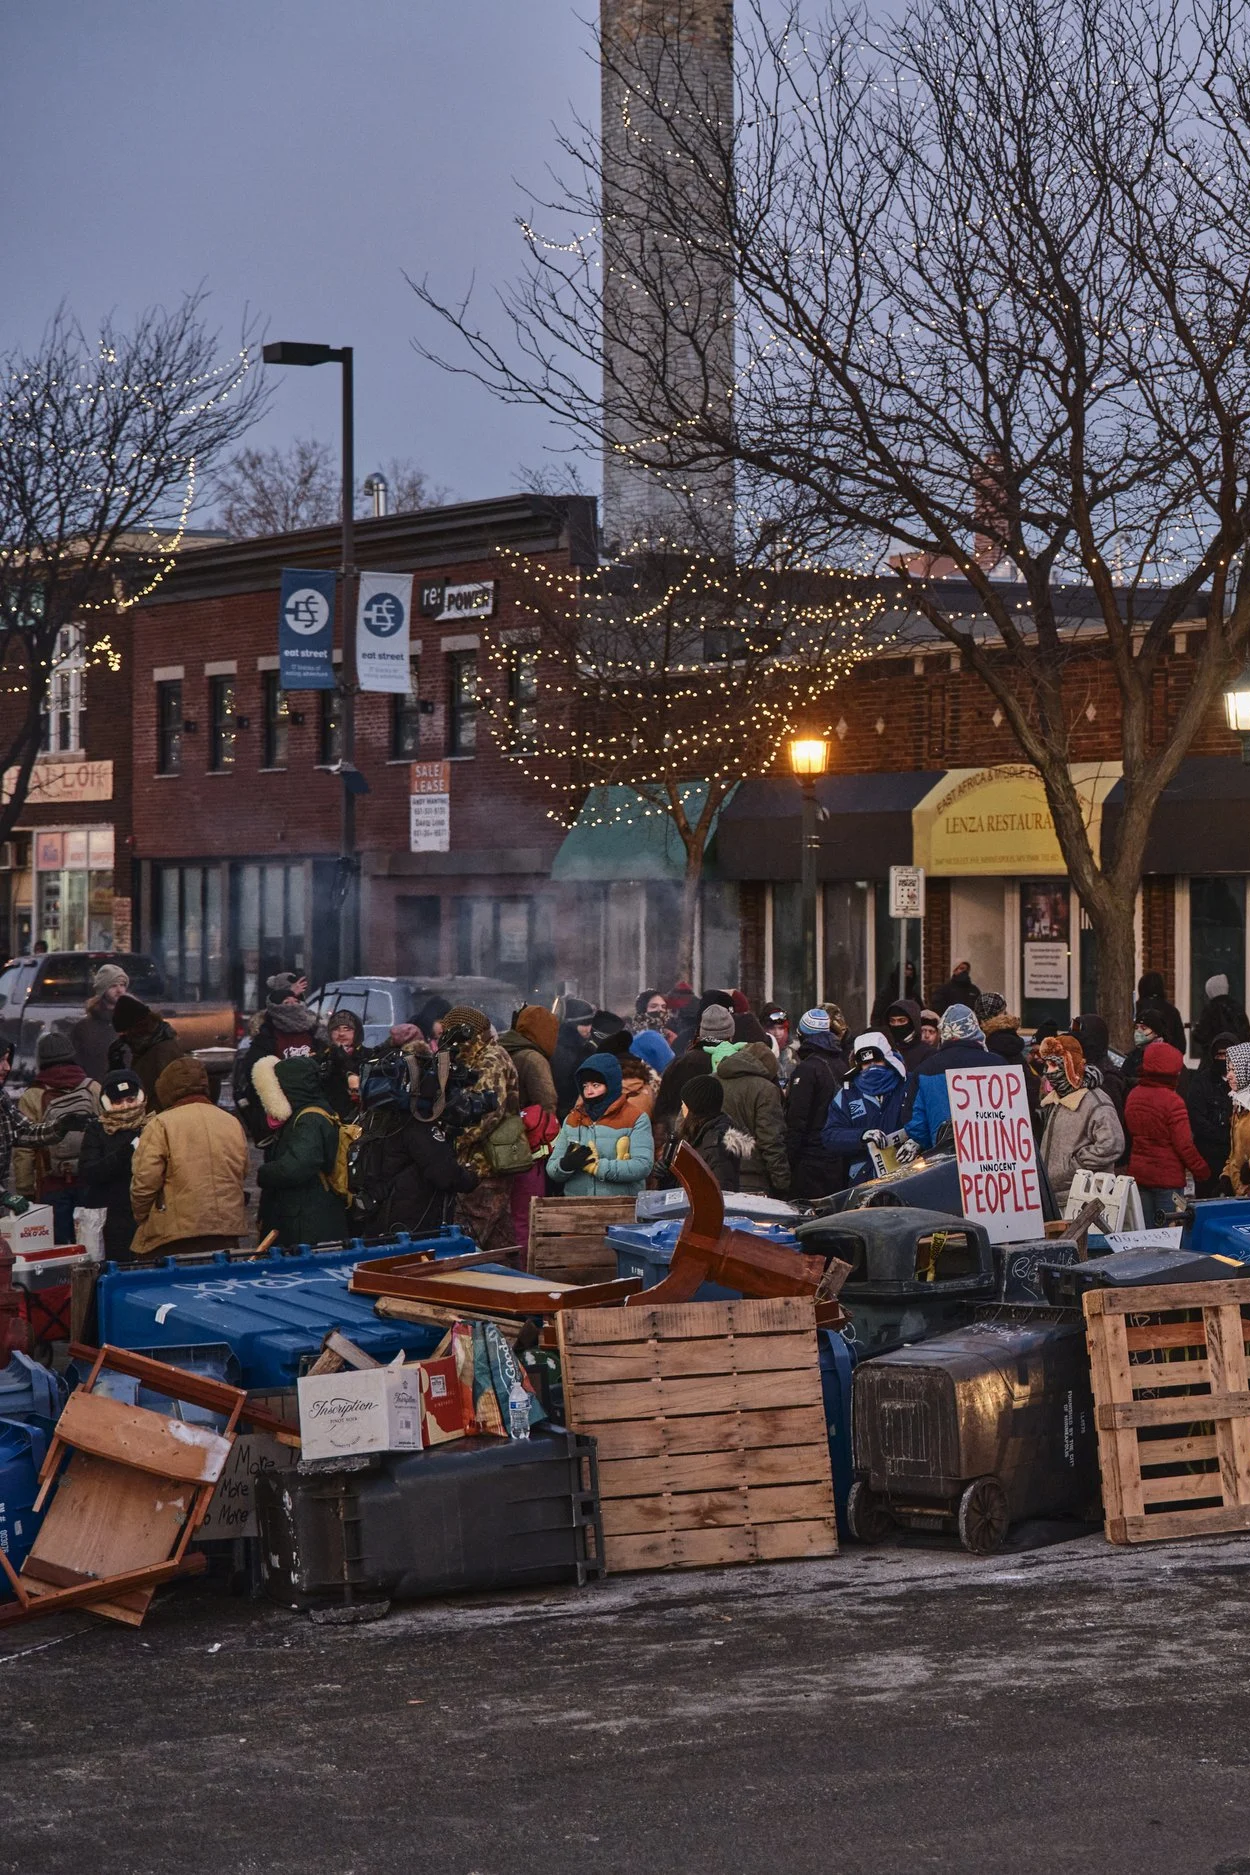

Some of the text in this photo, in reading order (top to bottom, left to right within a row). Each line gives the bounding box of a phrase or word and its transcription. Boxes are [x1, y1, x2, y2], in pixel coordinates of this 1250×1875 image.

[284, 649, 328, 659] eat street
[362, 652, 404, 661] eat street
[415, 780, 445, 792] LEASE
[937, 789, 957, 815] EAST
[957, 771, 986, 797] AFRICA
[945, 812, 1056, 834] LENZA RESTAURA
[952, 1072, 1021, 1110] STOP
[976, 1111, 1005, 1120] FUCKING
[955, 1117, 1032, 1163] KILLING
[979, 1162, 1016, 1173] INNOCENT
[961, 1169, 1040, 1215] PEOPLE
[309, 1398, 379, 1419] Inscription
[1068, 1428, 1074, 1436] BY
[235, 1444, 275, 1477] More
[220, 1478, 249, 1498] More
[219, 1504, 249, 1526] More
